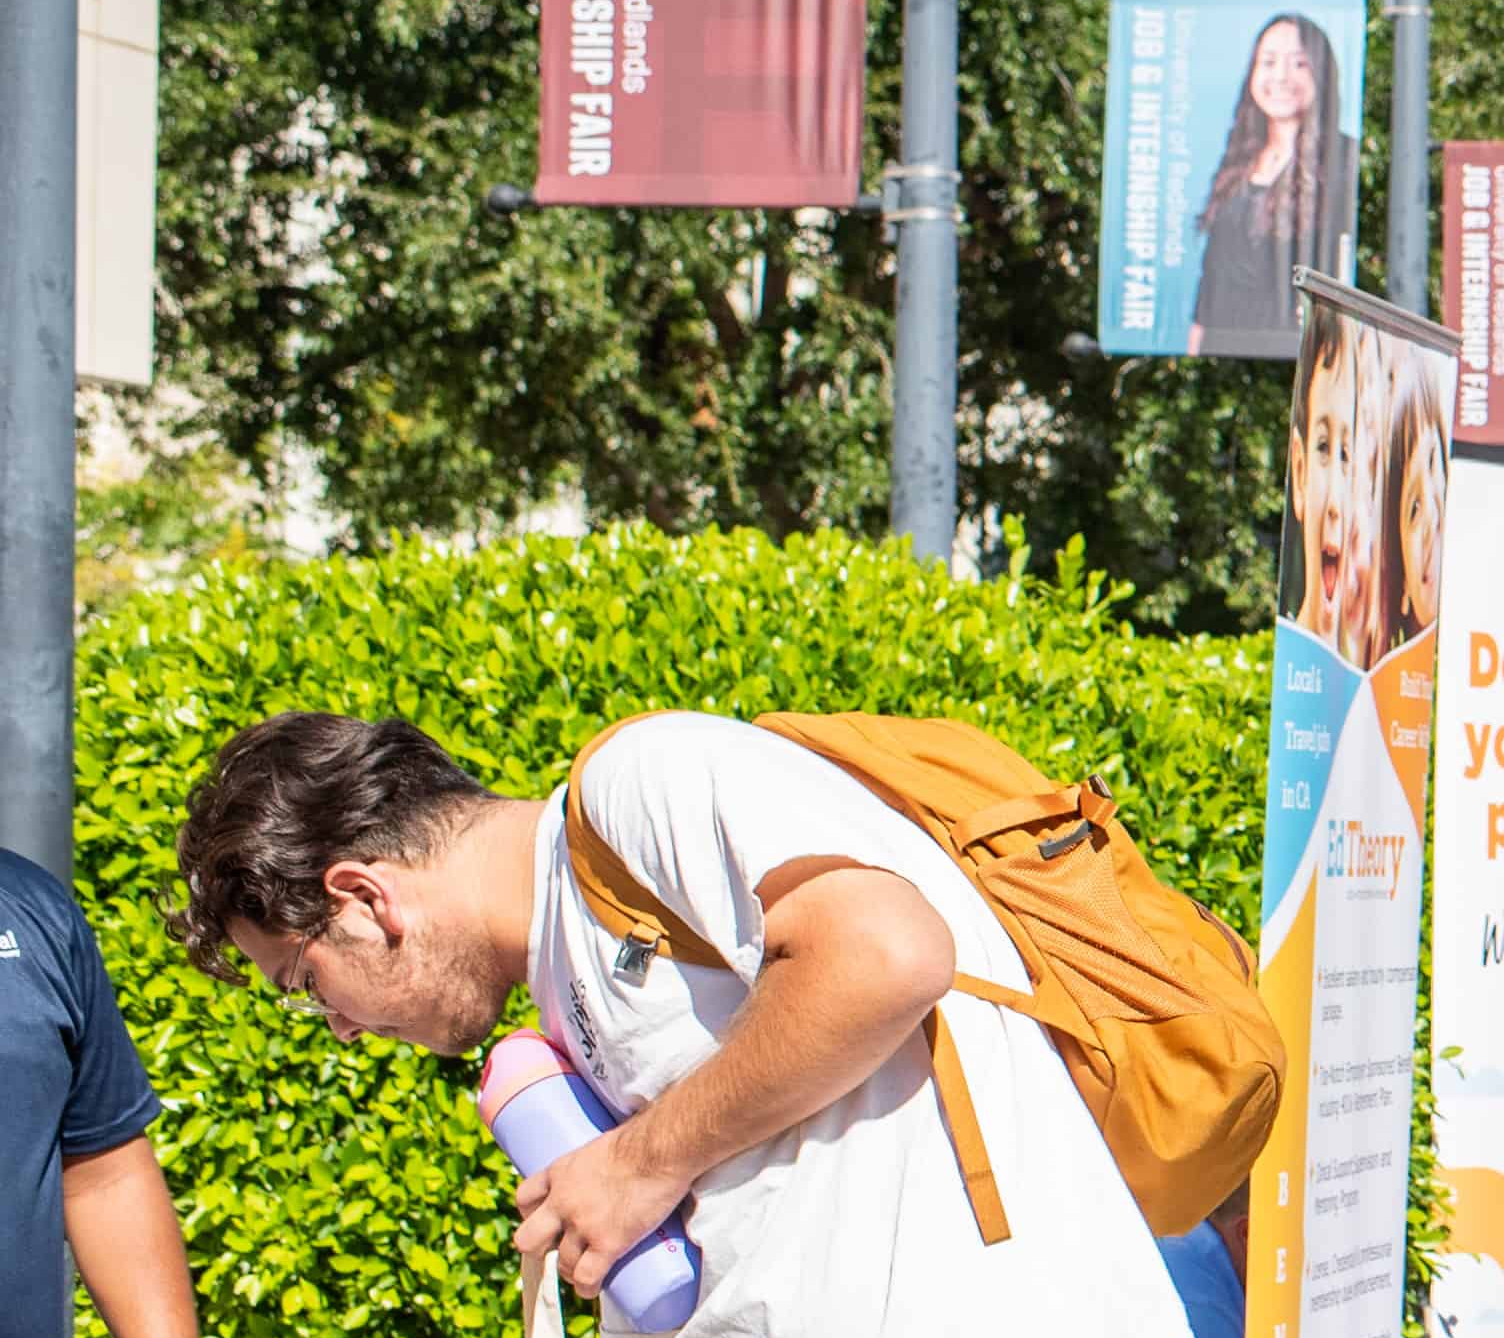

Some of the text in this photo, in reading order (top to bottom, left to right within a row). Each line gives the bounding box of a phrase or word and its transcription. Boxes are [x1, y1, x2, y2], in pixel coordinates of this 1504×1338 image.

[1132, 8, 1165, 55] JOB
[568, 92, 613, 177] FAIR
[1124, 92, 1162, 261] INTERNSHIP
[1462, 163, 1491, 209] JOB
[1122, 266, 1157, 330] FAIR
[1461, 232, 1490, 371] INTERNSHIP
[1459, 372, 1489, 427] FAIR
[1326, 819, 1406, 901] EdTheory
